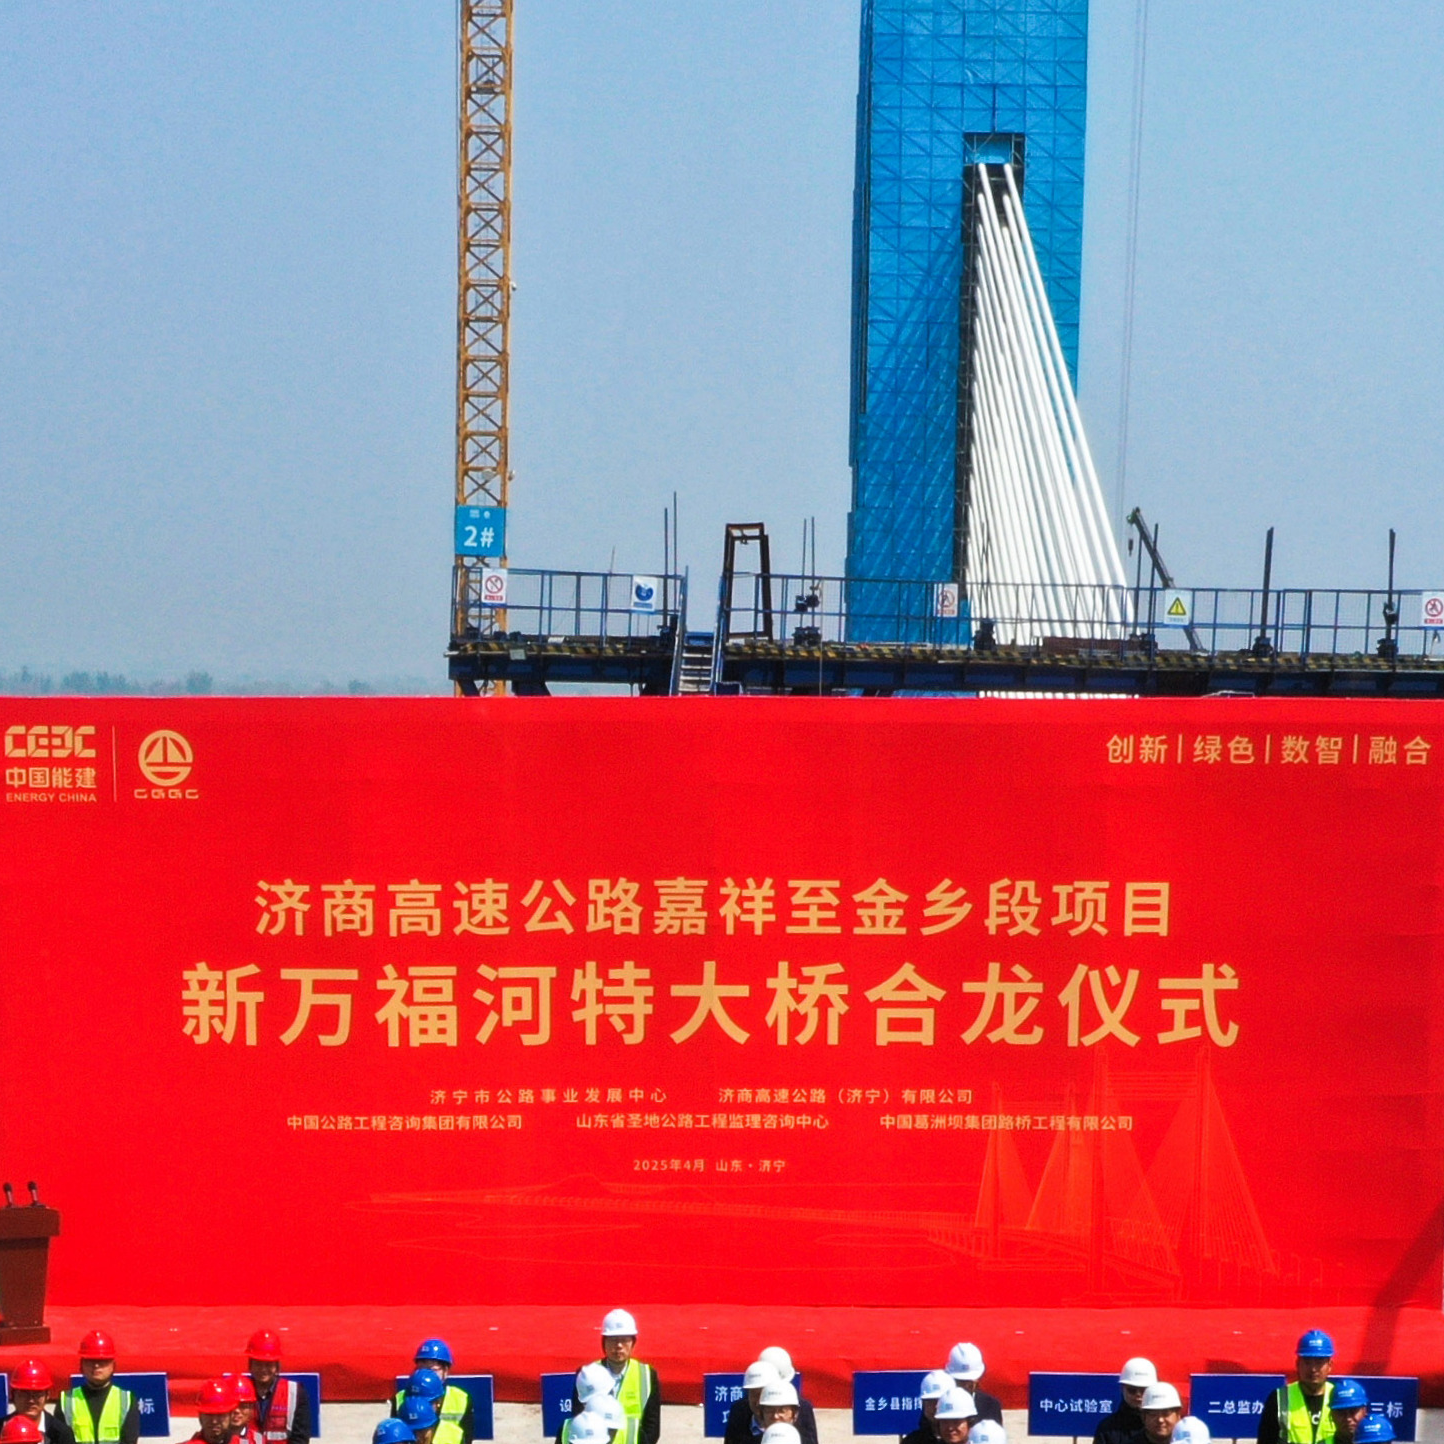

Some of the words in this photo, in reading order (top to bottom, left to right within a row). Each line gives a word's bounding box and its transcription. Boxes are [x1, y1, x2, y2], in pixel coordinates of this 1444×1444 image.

[463, 525, 495, 548] 2#
[5, 767, 97, 789] 中国能建
[6, 792, 55, 803] ENERGY
[58, 792, 97, 803] CHINA
[134, 788, 199, 799] CGGC
[255, 876, 1170, 937] 济商高速公路嘉祥至金乡段项目
[182, 960, 1239, 1047] 新万福河特大桥合龙仪式
[429, 1087, 667, 1106] 济宁市公路事业发展中心
[287, 1113, 523, 1131] 中国公路工程咨询集团有限公司
[576, 1113, 830, 1131] 山东省圣地公路工程监理咨询中心
[880, 1113, 1134, 1131] 中国葛洲坝集团路桥工程有限公司
[633, 1159, 706, 1173] 2025年4月
[1039, 1398, 1114, 1414] 中心试验室
